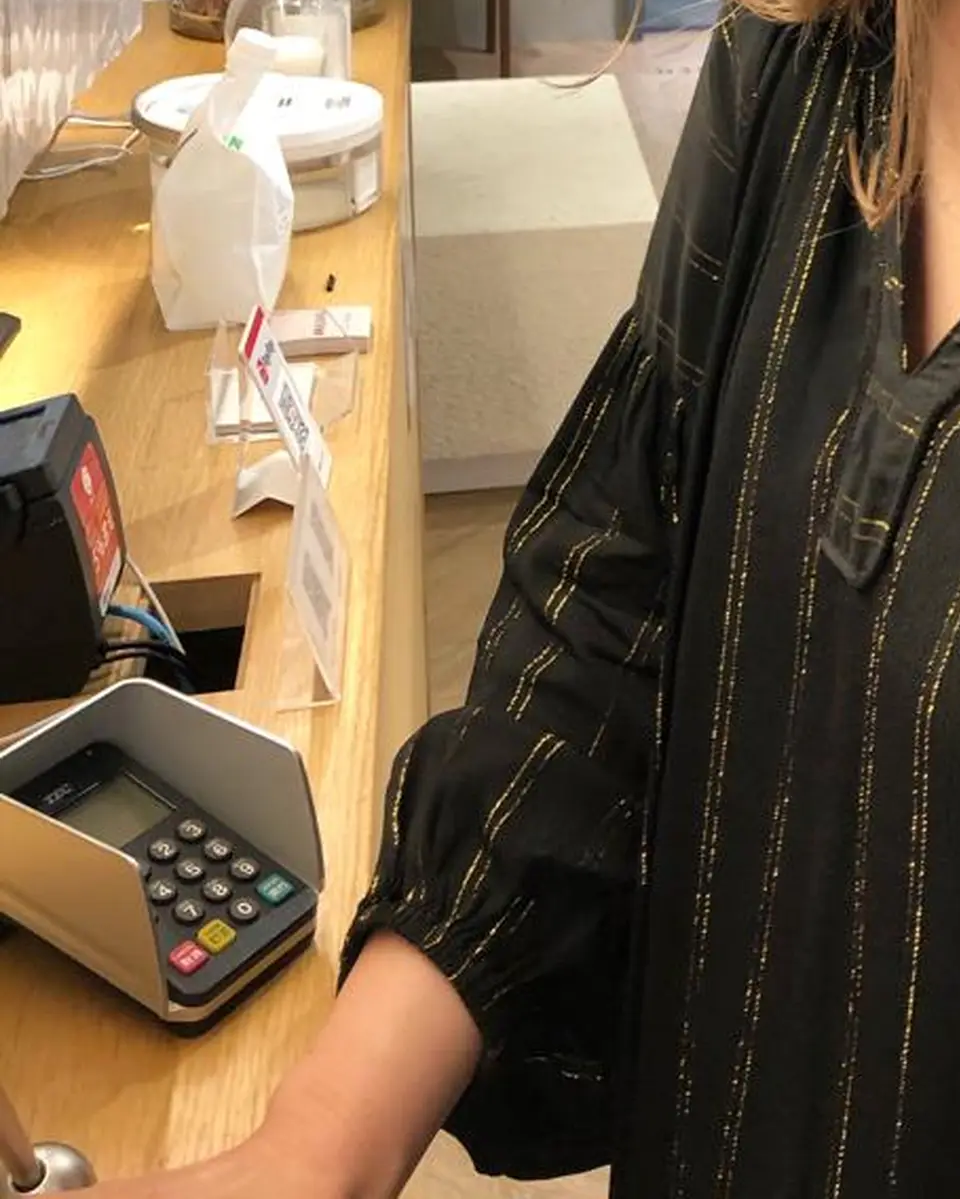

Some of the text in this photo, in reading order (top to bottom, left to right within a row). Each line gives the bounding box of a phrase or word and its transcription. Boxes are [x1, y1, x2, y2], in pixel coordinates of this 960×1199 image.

[185, 823, 202, 837] 3
[159, 884, 173, 896] 4
[185, 863, 201, 876] 5
[183, 862, 254, 917] 7 8 9
[236, 902, 252, 915] 0
